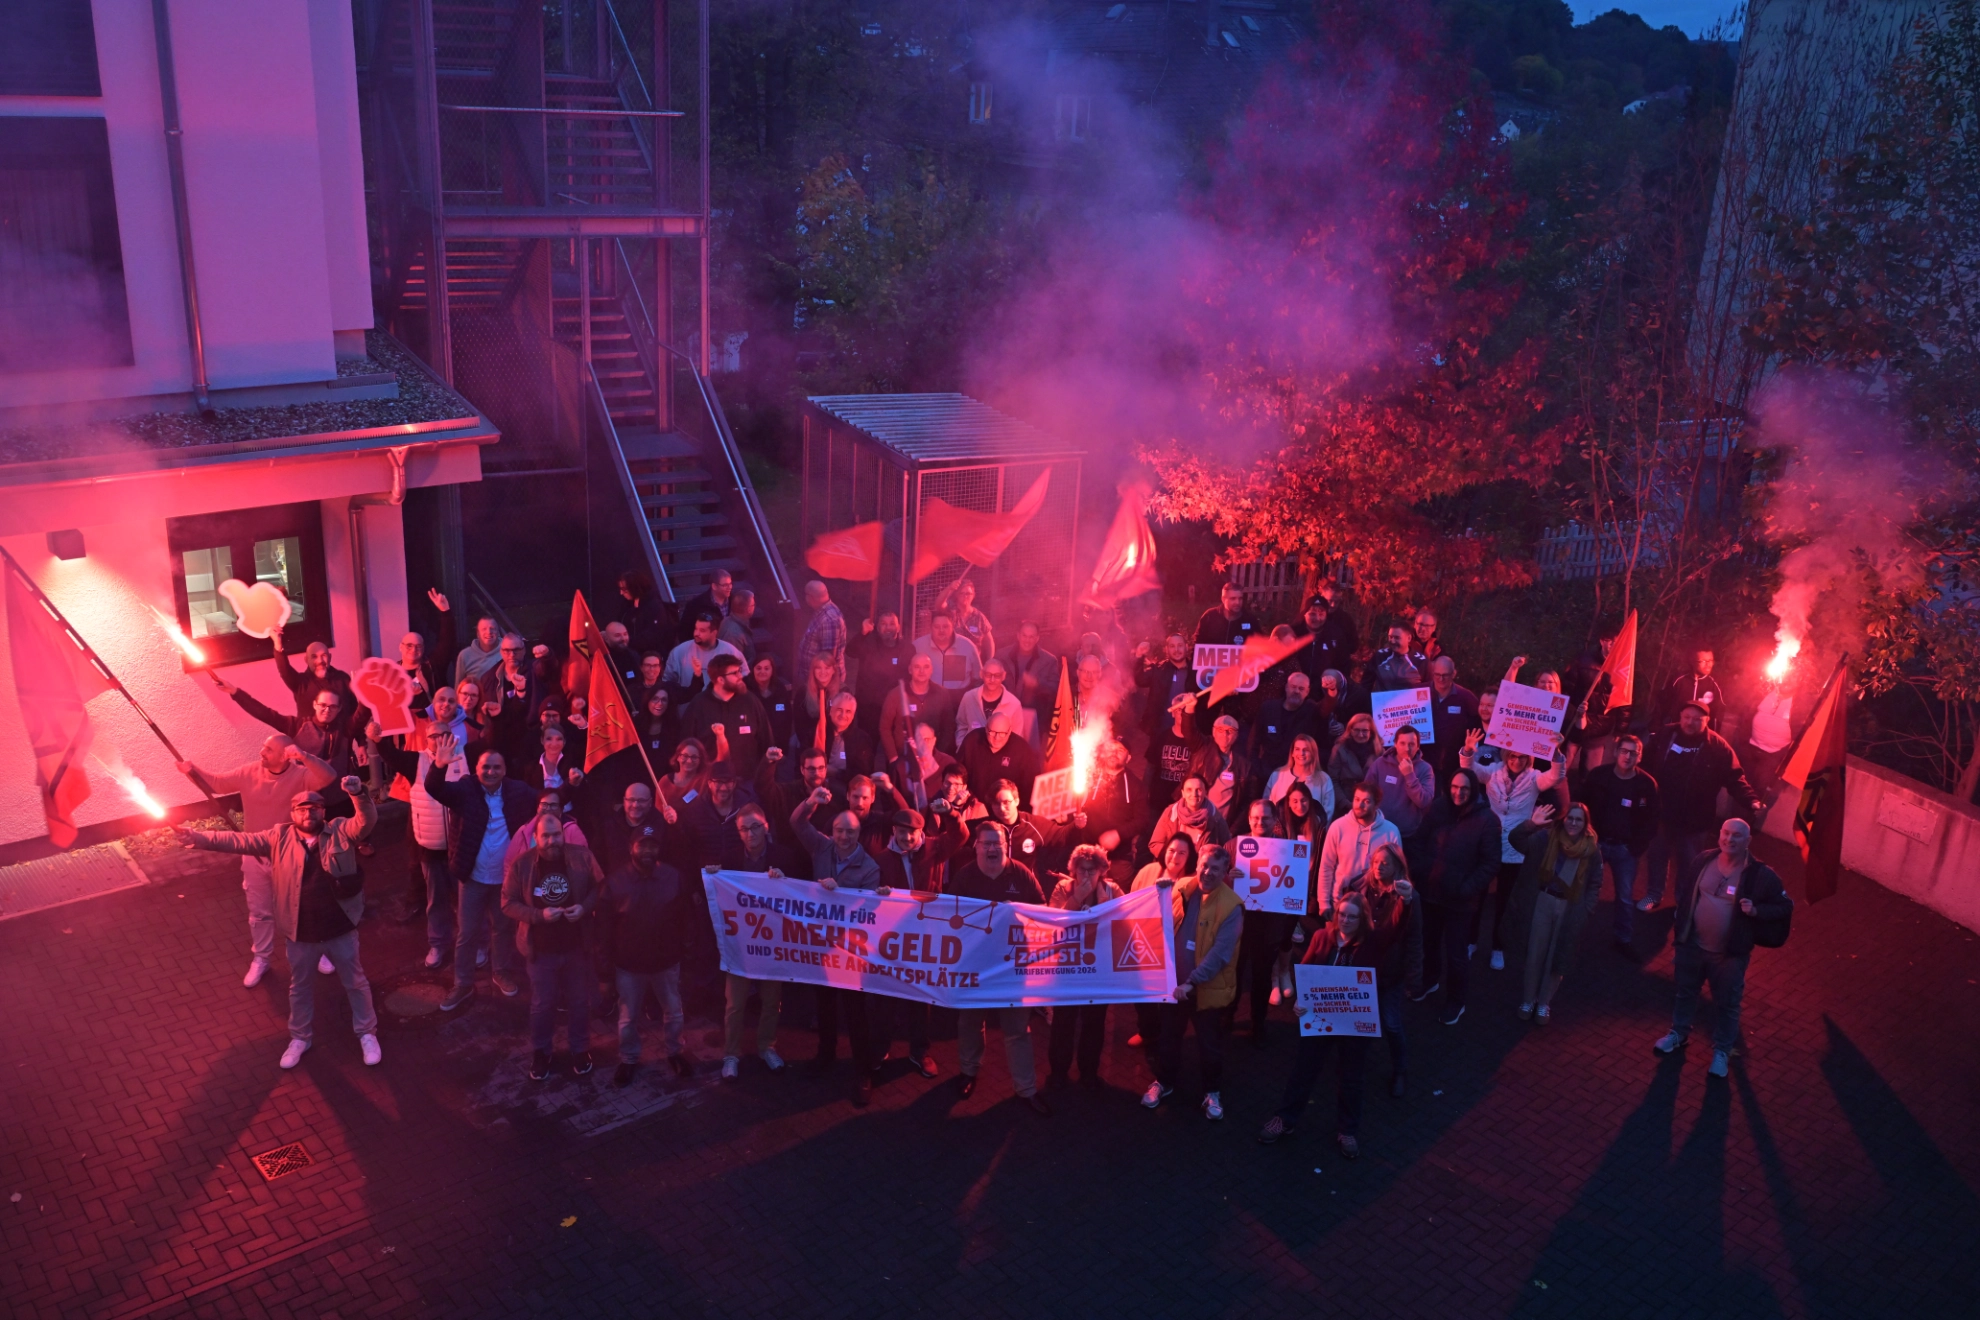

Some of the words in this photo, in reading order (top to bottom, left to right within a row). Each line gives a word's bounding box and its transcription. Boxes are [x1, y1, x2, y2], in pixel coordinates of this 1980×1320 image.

[1197, 648, 1243, 667] MEH
[1390, 709, 1409, 718] MEHR
[1410, 707, 1427, 715] GELD
[1507, 703, 1541, 713] GEMEINSAM
[1514, 710, 1536, 720] MEHR
[1537, 714, 1557, 723] GELD
[1502, 721, 1554, 736] ARBEITSPLÄTZE
[1250, 859, 1295, 895] 5%
[737, 891, 846, 922] GEMEINSAM
[850, 908, 877, 925] FÜR
[722, 910, 739, 937] 5
[744, 912, 774, 941] %
[782, 916, 869, 957] MEHR
[878, 931, 963, 965] GELD
[1011, 927, 1049, 943] WEIL
[1057, 927, 1078, 942] DU
[746, 944, 772, 957] UND
[774, 946, 841, 969] SICHERE
[1014, 966, 1076, 976] TARIFBEWEGUNG
[1077, 966, 1097, 974] 2026
[1310, 993, 1319, 1001] %
[1321, 992, 1346, 1000] MEHR
[1347, 992, 1370, 1000] GELD
[1313, 1005, 1372, 1014] ARBEITSPLÄTZE
